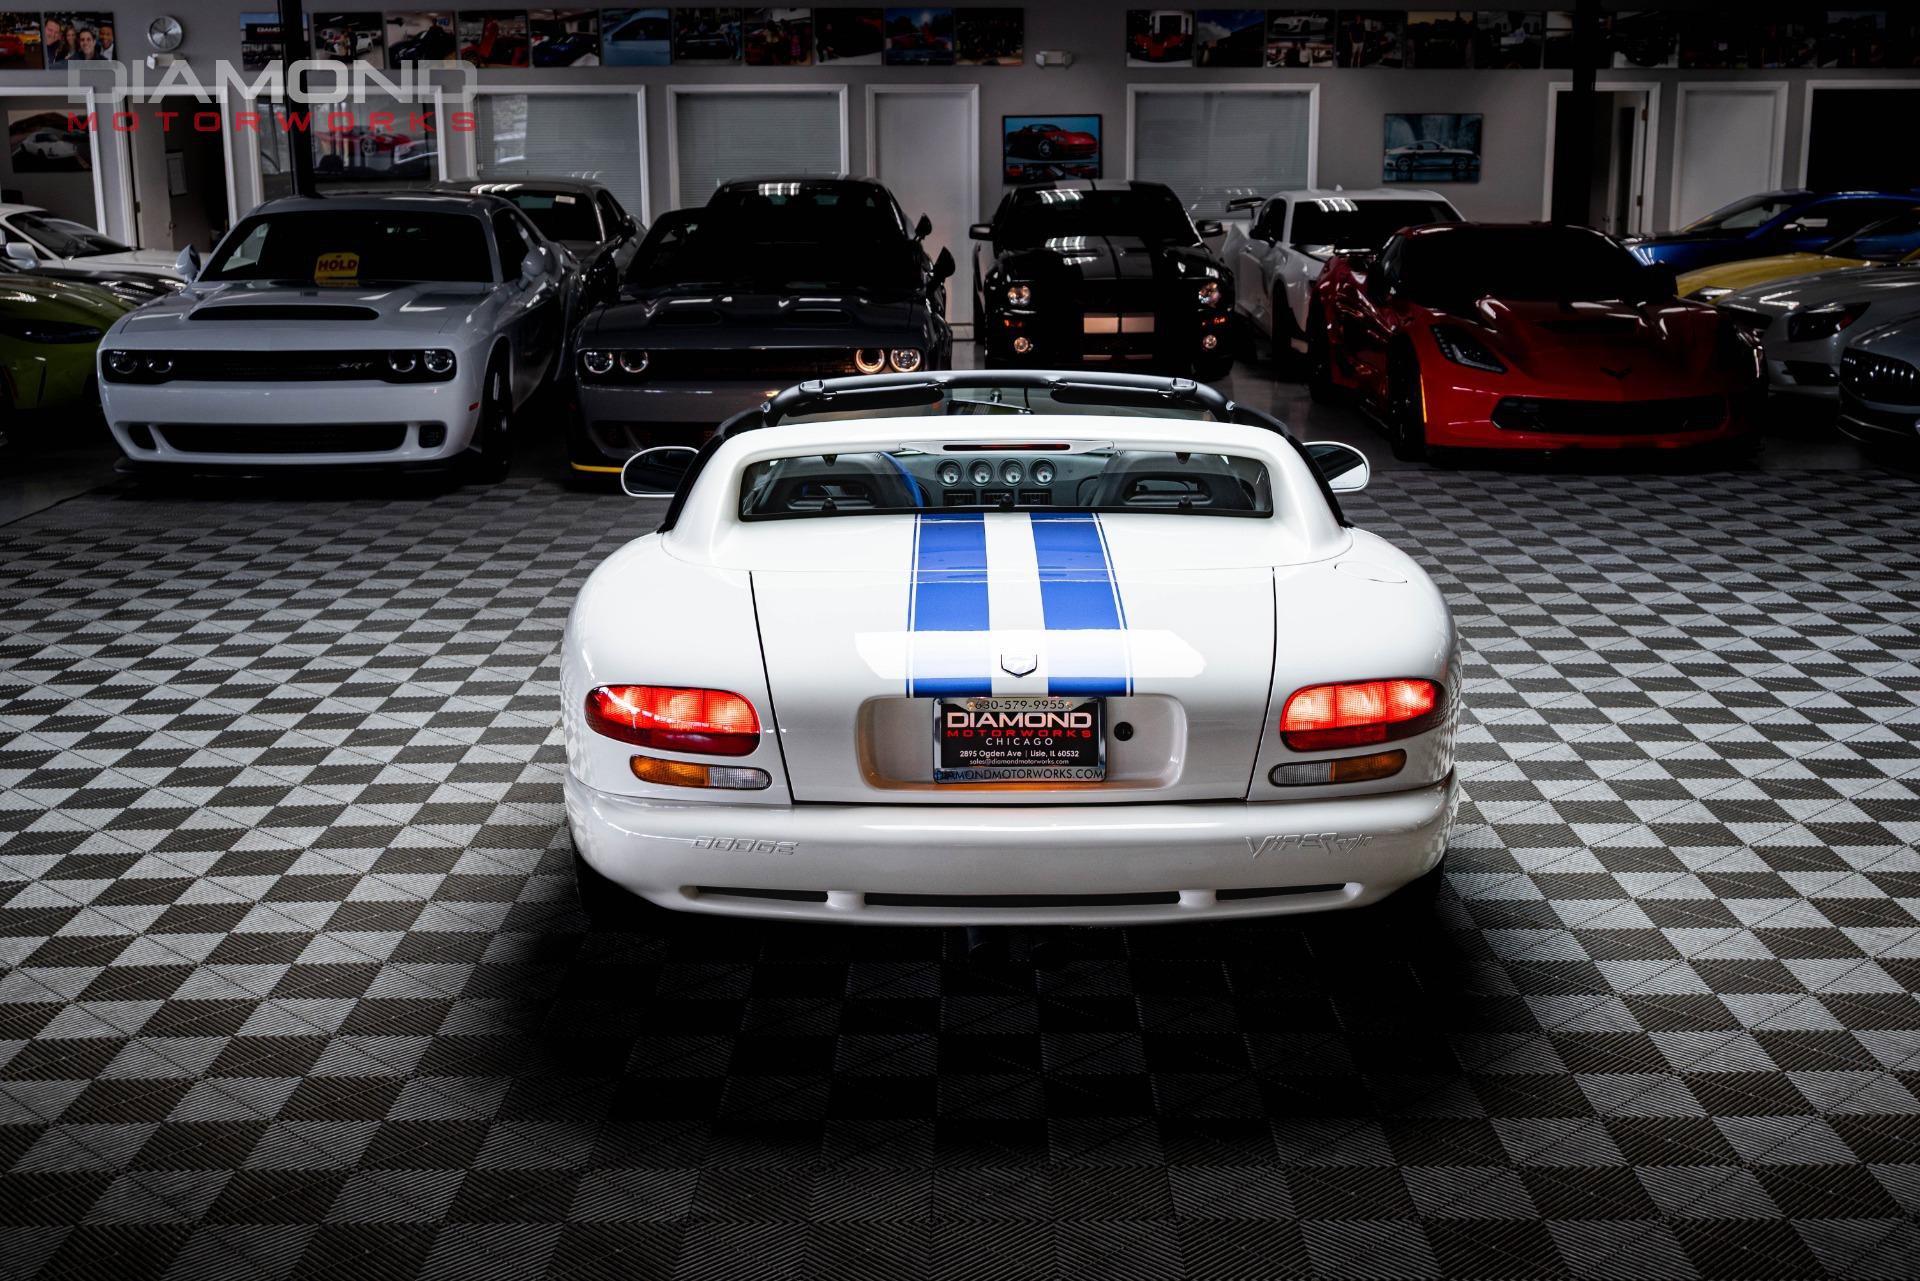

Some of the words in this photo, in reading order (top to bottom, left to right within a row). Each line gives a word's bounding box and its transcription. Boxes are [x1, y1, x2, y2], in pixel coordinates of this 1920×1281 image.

[317, 259, 358, 272] HOLD
[975, 700, 1065, 710] 630-579-9955
[947, 712, 1092, 728] DIAMOND
[946, 729, 1092, 738] MOTORWORKS
[985, 737, 1053, 746] CHICAGO
[959, 750, 977, 758] 2895
[979, 750, 1005, 759] Ogden
[1006, 750, 1022, 758] Ave
[1057, 750, 1080, 758] 60532
[969, 758, 1070, 766] sales@diamondmotorworks.com
[690, 835, 801, 857] DODGE
[1244, 832, 1338, 860] VIPER
